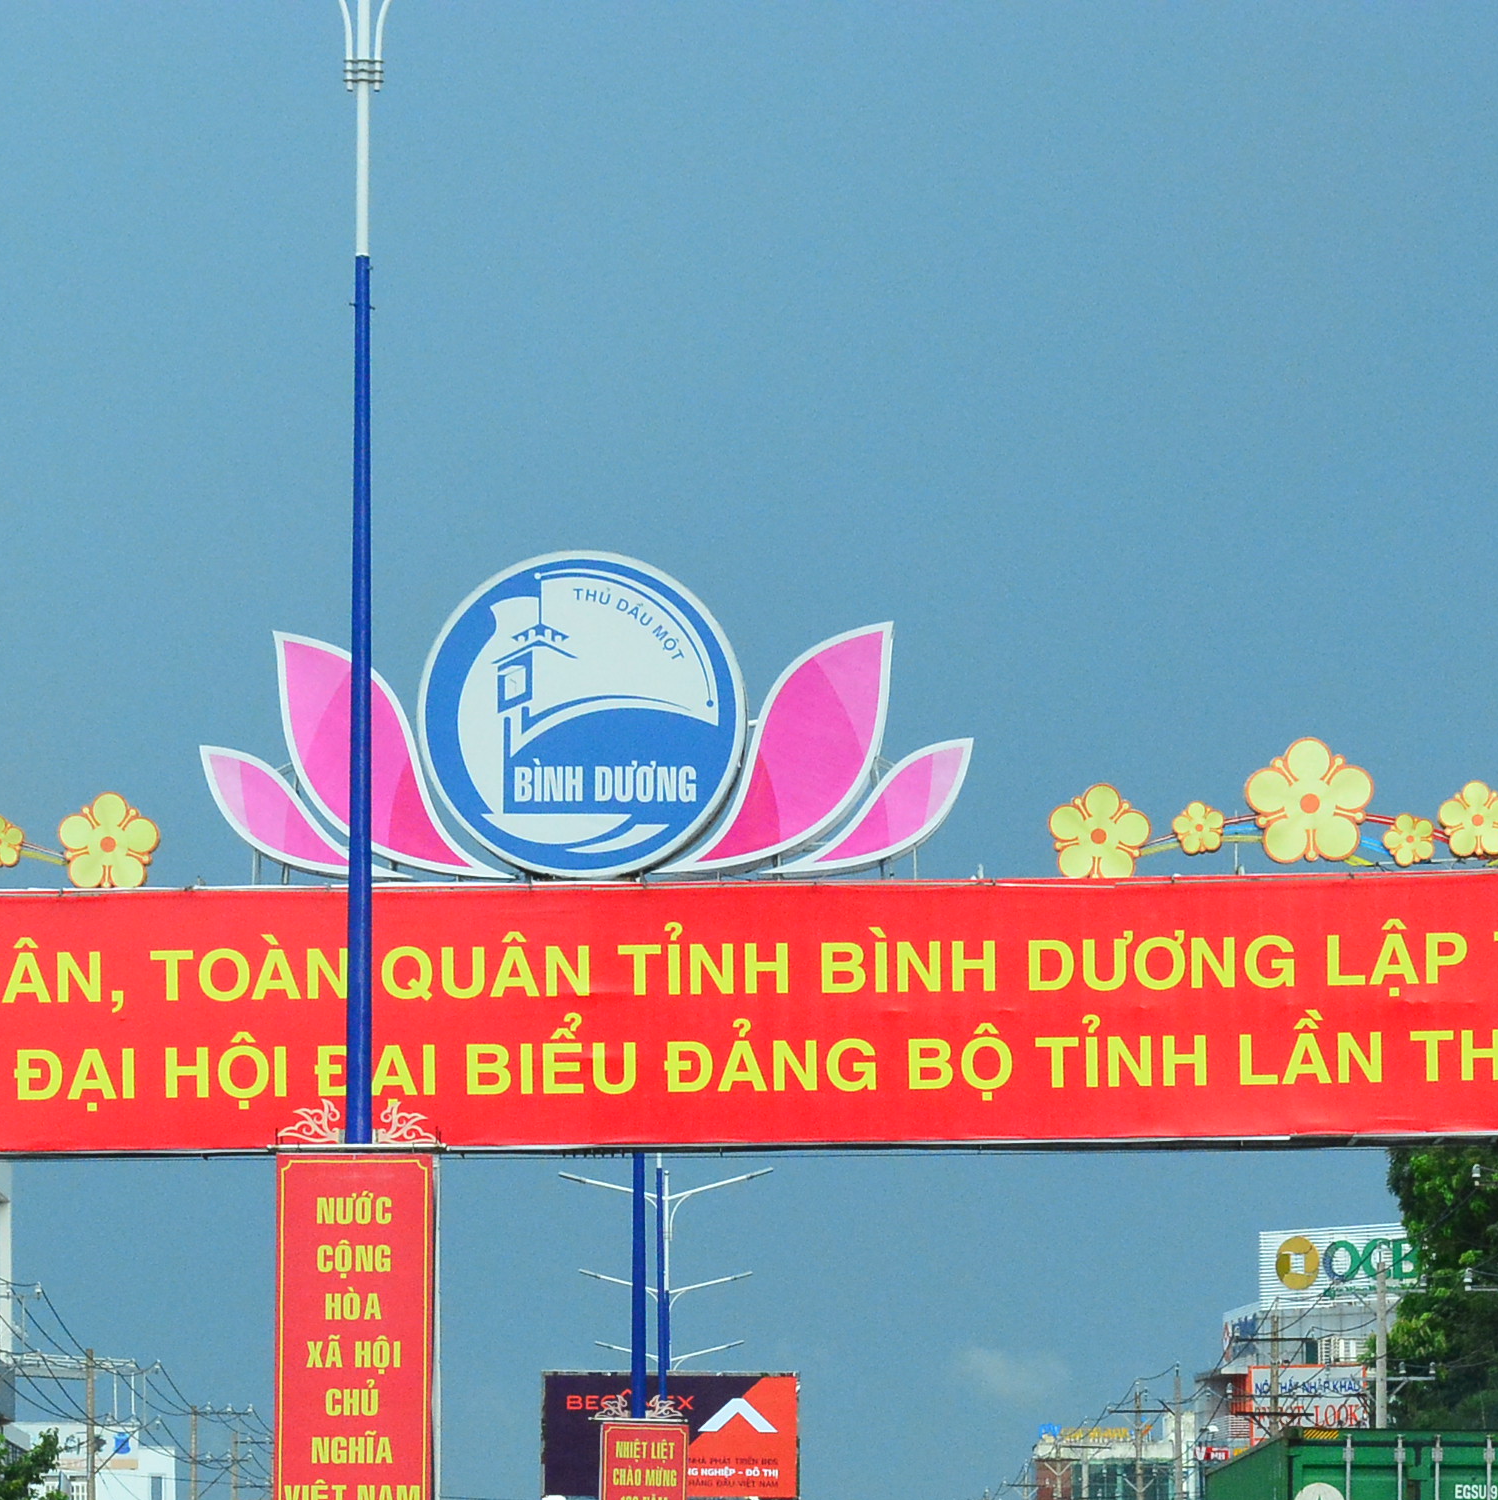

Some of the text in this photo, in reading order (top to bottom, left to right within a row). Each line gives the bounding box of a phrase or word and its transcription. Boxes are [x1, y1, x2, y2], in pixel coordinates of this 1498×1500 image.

[573, 587, 685, 660] THỦ DẦU MỘT
[514, 758, 697, 802] BÌNH DƯƠNG
[150, 934, 347, 1001] TOÀN
[382, 932, 590, 1000] QUÂN
[618, 922, 788, 995] TỈNH
[821, 927, 995, 993] BÌNH
[1029, 930, 1294, 991] DƯƠNG
[1327, 919, 1467, 997] LẬP
[14, 1048, 134, 1111] ĐẠI
[165, 1032, 287, 1109] HỘI
[315, 1044, 435, 1109] ĐẠI
[467, 1013, 636, 1094] BIỂU
[664, 1018, 876, 1092] ĐẢNG
[909, 1023, 1012, 1100] BỘ
[1035, 1014, 1207, 1088] TỈNH
[1239, 1010, 1381, 1085] LẦN
[317, 1191, 392, 1224] NƯỚC
[317, 1239, 391, 1279] CỘNG
[326, 1287, 381, 1320] HÒA
[307, 1335, 400, 1374] XÃ HỘI
[326, 1379, 378, 1416] CHỦ
[312, 1430, 393, 1464] NGHĨA
[616, 1438, 675, 1463] NHIỆT LIỆT
[613, 1466, 642, 1486] CHÀO
[645, 1466, 677, 1487] MỪNG
[701, 1466, 736, 1478] NGHIỆP
[745, 1466, 760, 1477] ĐÔ
[762, 1468, 779, 1479] THỊ
[1455, 1484, 1486, 1499] EGSU
